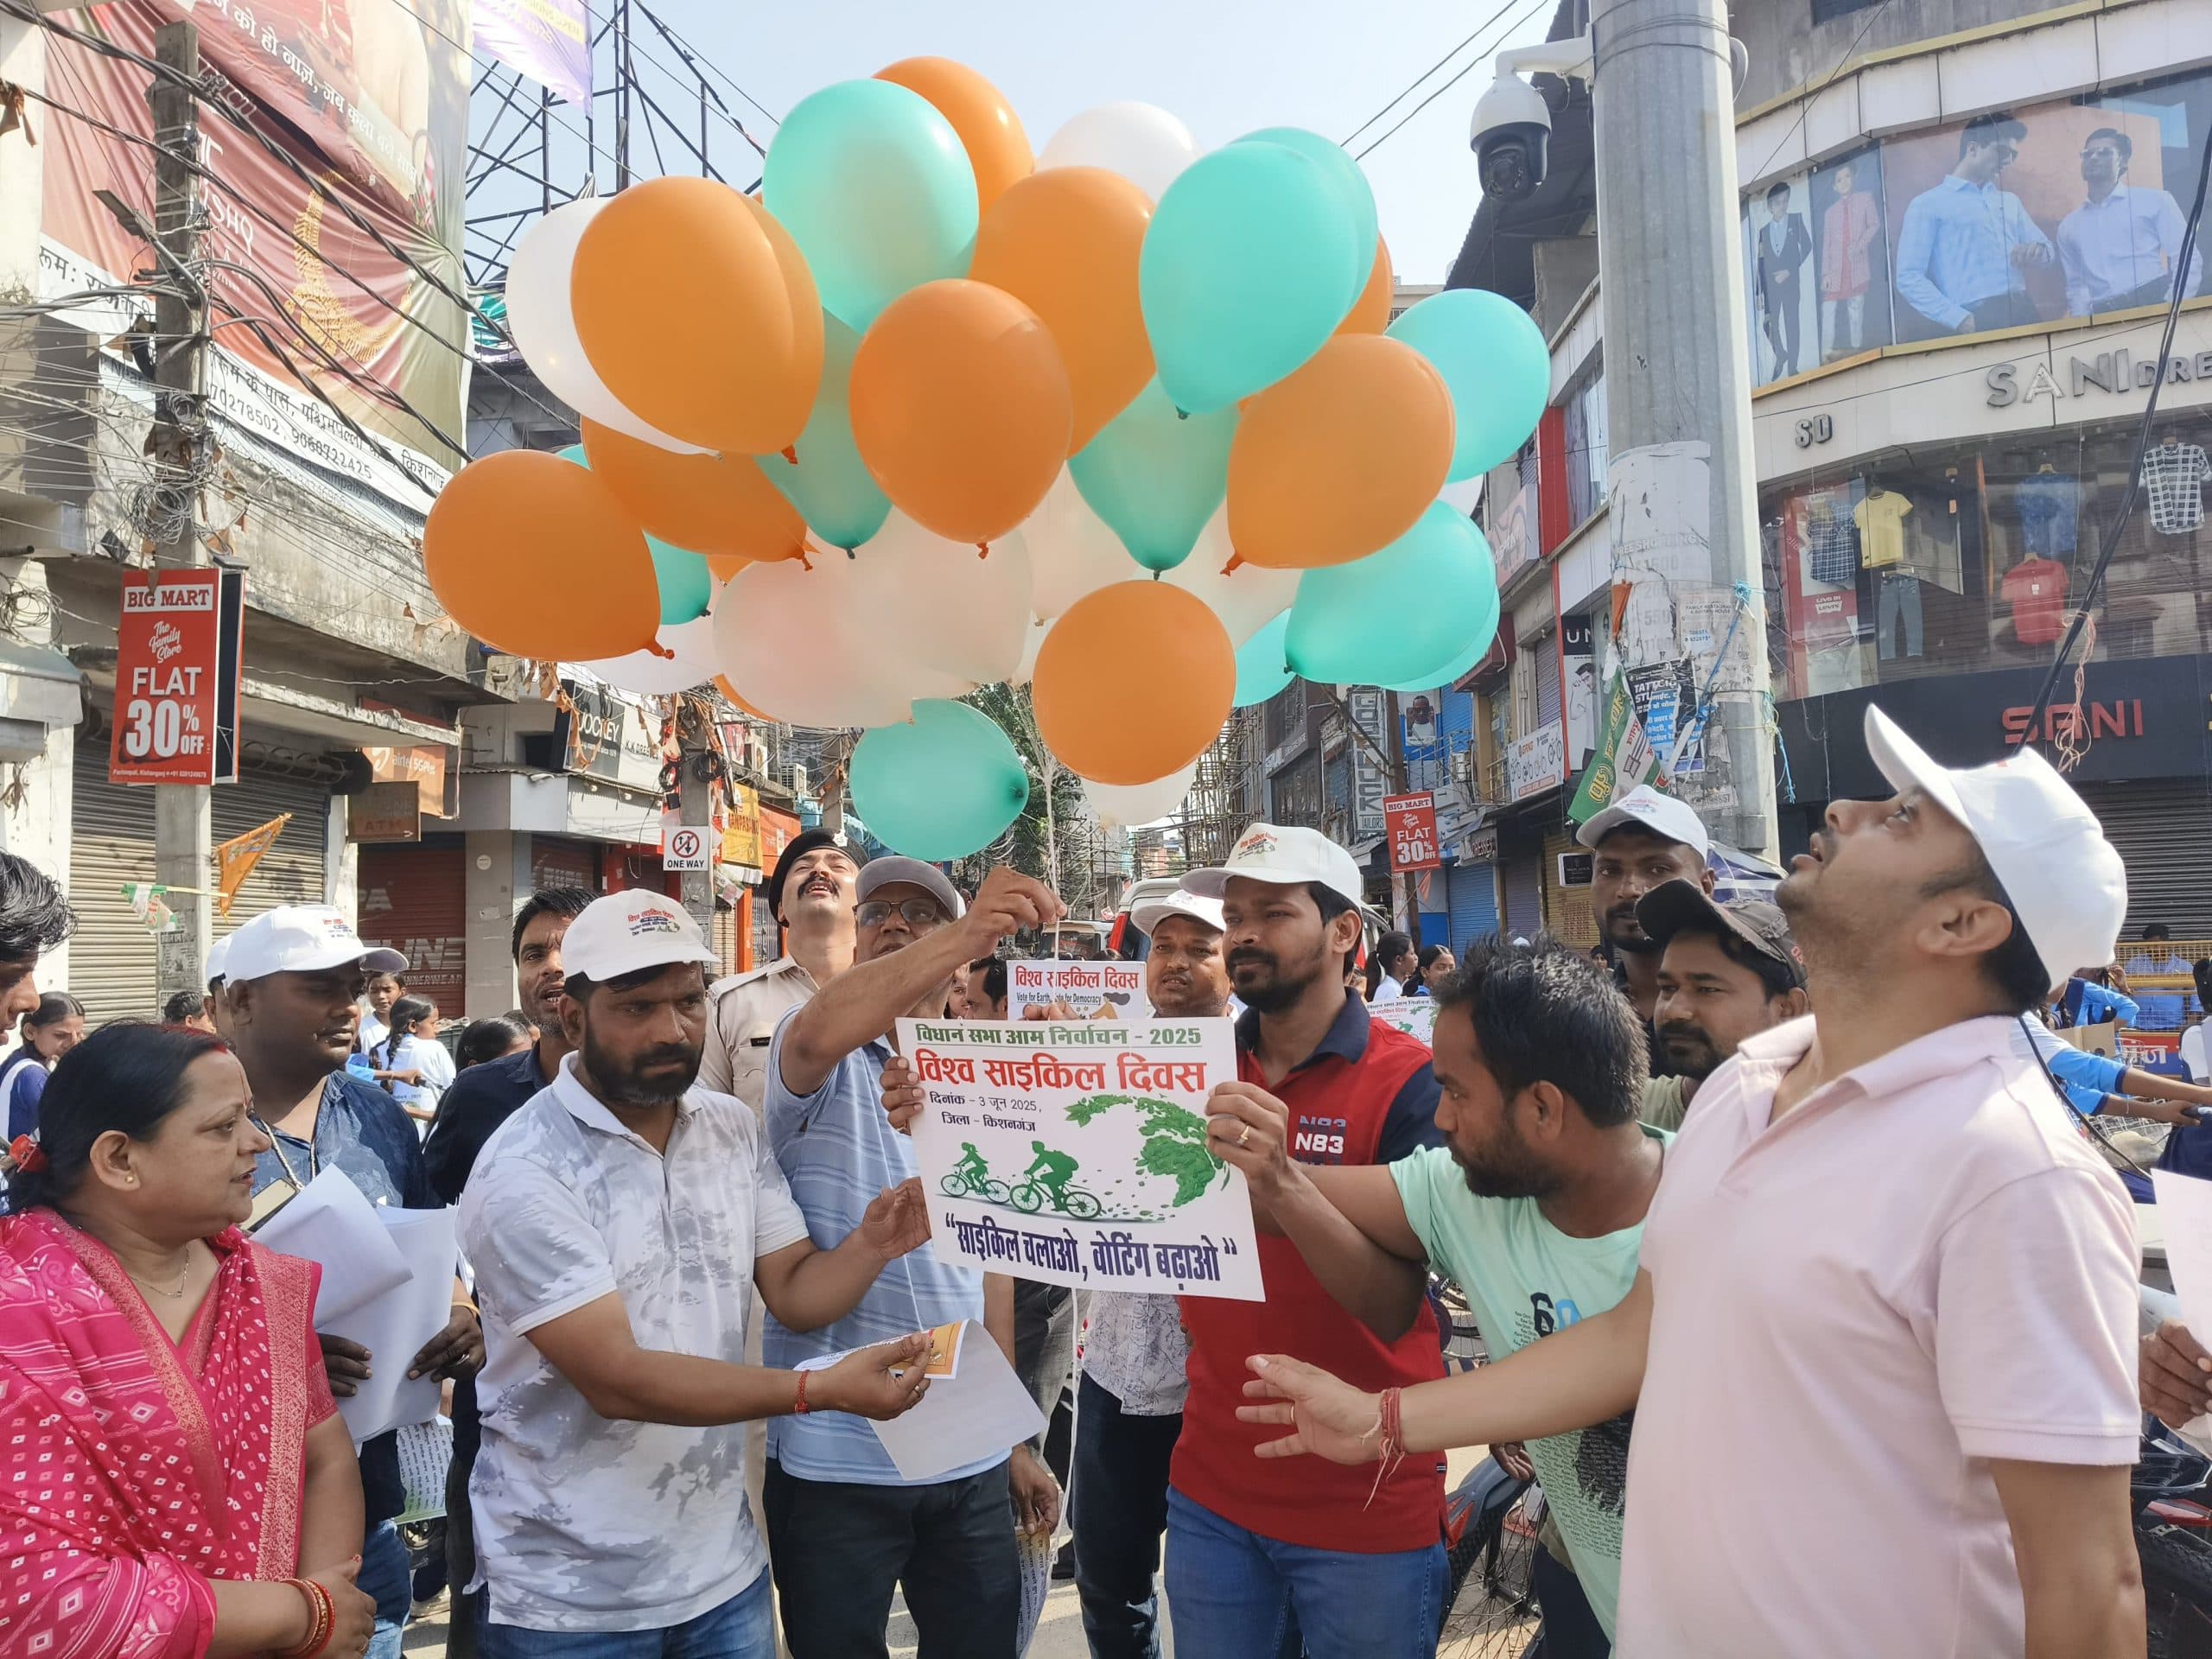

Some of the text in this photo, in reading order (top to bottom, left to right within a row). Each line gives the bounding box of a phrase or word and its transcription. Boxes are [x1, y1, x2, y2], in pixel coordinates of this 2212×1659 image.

[233, 7, 257, 38] को
[261, 25, 278, 56] हो
[323, 81, 346, 113] जब
[1986, 348, 2212, 408] SANI DRE
[1796, 414, 1833, 448] SD
[127, 588, 209, 607] BIG MART
[132, 666, 202, 696] FLAT
[2002, 698, 2144, 744] SANI
[180, 735, 205, 755] OFF
[393, 754, 412, 768] airtel
[1388, 798, 1431, 811] BIG MART
[1396, 827, 1431, 842] FLAT
[667, 859, 704, 868] ONE WAY
[1015, 965, 1043, 988] विश्व
[1104, 966, 1139, 989] दिवस
[1016, 993, 1027, 1002] Vote
[1073, 995, 1102, 1005] Democracy
[916, 1023, 963, 1044] विधान
[968, 1027, 1001, 1044] सभा
[1007, 1028, 1045, 1045] आम
[1049, 1024, 1129, 1045] निर्वाचन
[1149, 1027, 1202, 1045] 2025
[916, 1048, 1207, 1093] विश्व साइकिल दिवस
[929, 1090, 966, 1107] दिनांक
[979, 1096, 986, 1108] 3
[988, 1096, 1007, 1113] जून
[942, 1111, 970, 1128] जिला
[982, 1113, 1036, 1134] किशनगंज
[1295, 1132, 1344, 1154] N83
[1021, 1227, 1088, 1281] चलाओ,
[1090, 1230, 1152, 1278] वोटिंग
